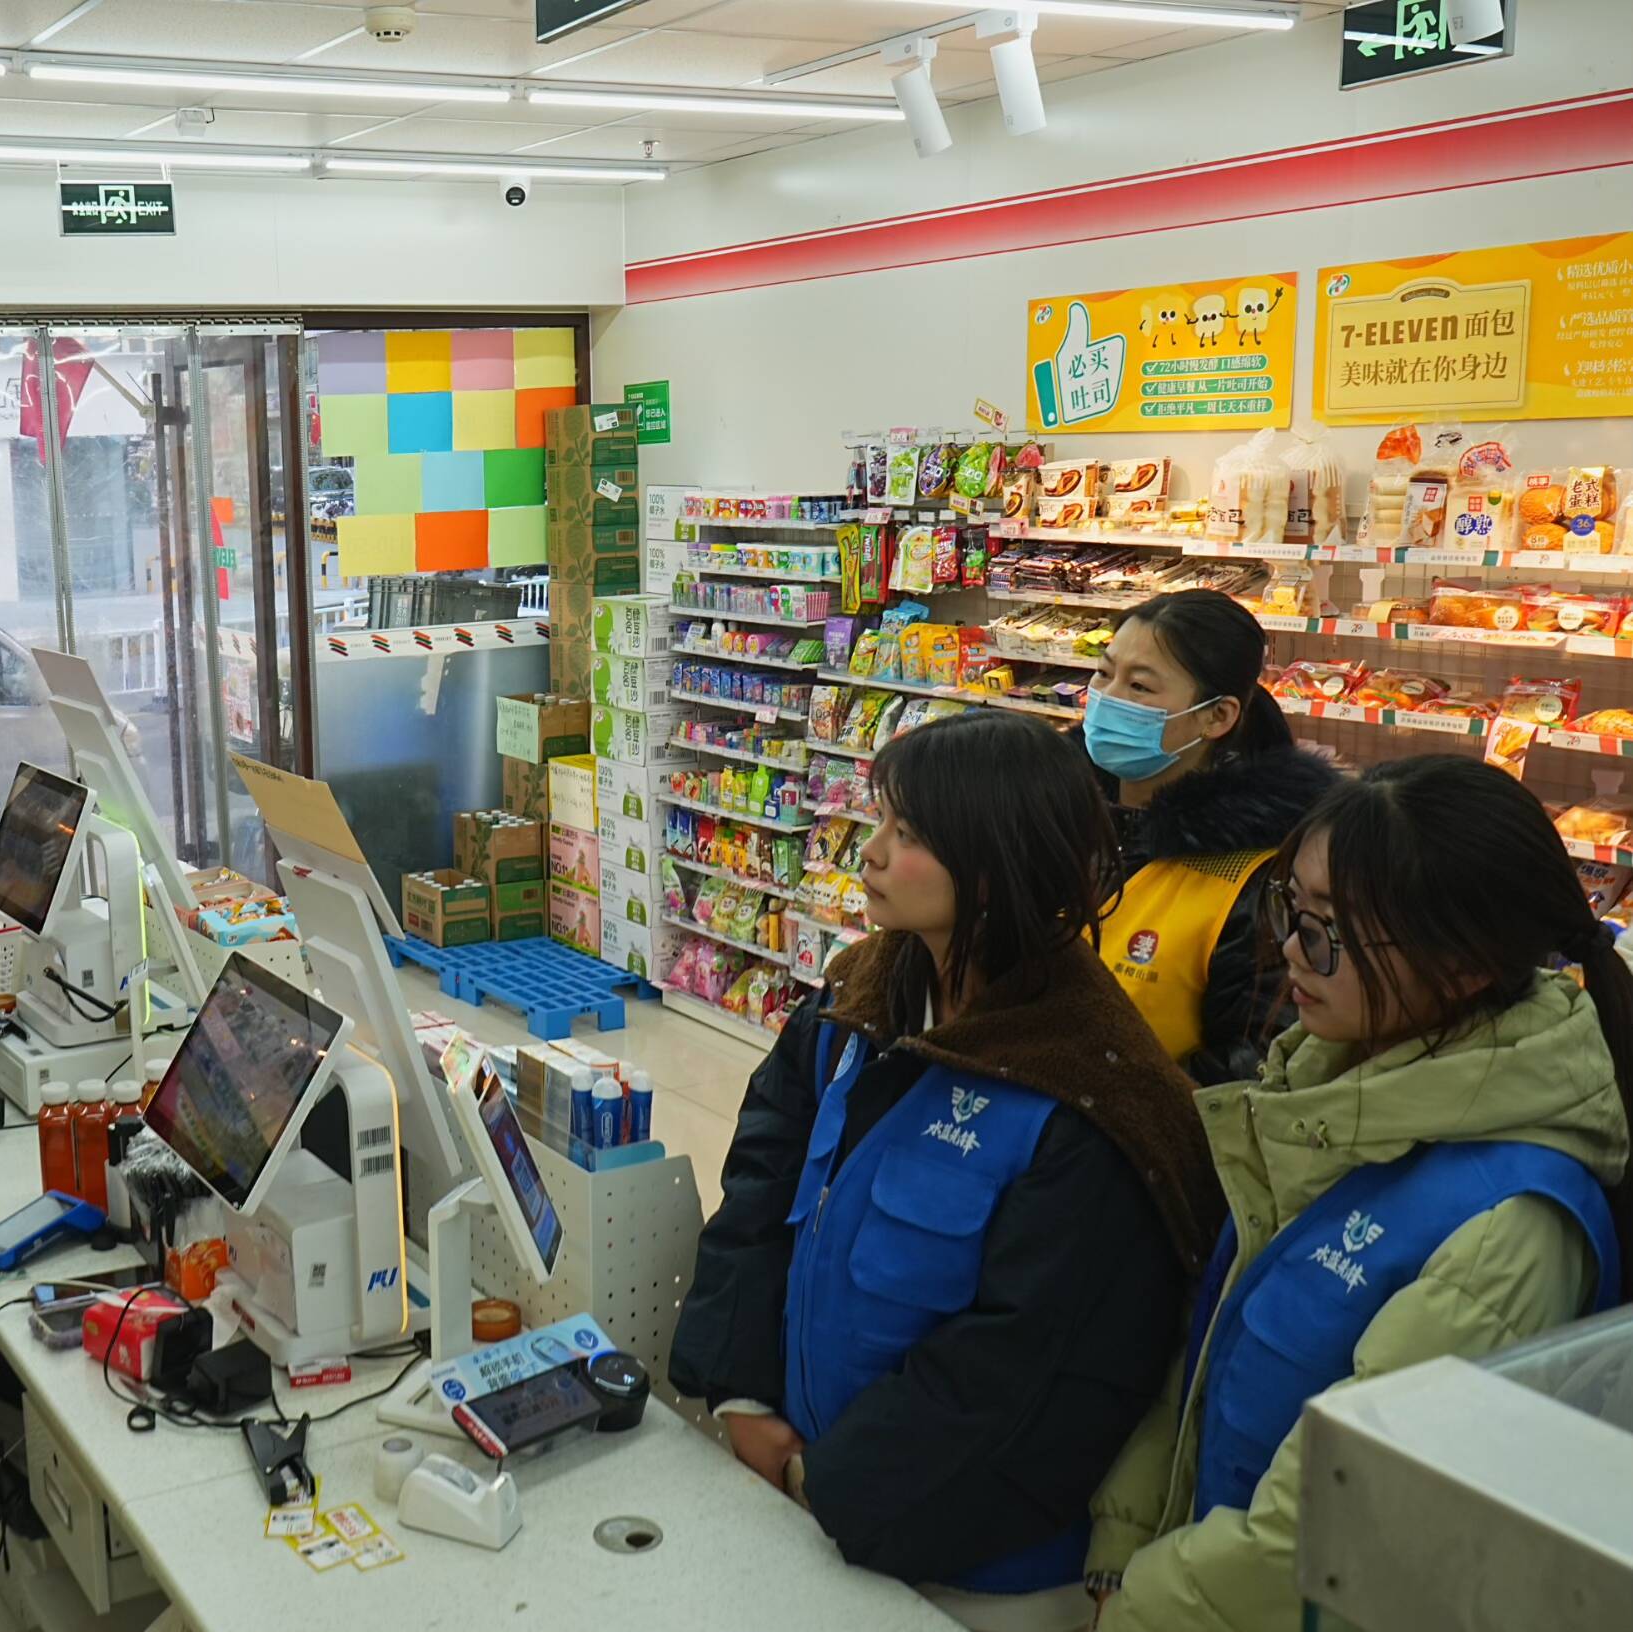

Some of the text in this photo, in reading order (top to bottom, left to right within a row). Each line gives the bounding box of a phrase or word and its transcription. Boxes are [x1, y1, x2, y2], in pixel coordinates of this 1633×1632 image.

[137, 200, 164, 216] EXIT
[1465, 309, 1516, 340] 面包
[1067, 345, 1110, 380] 必买
[1340, 351, 1508, 389] 美味就在你身边
[1070, 377, 1111, 413] 吐司
[1157, 376, 1269, 395] 健康早餐 从一片吐司开始
[1157, 398, 1267, 416] 拒绝平凡 一周七天不重样
